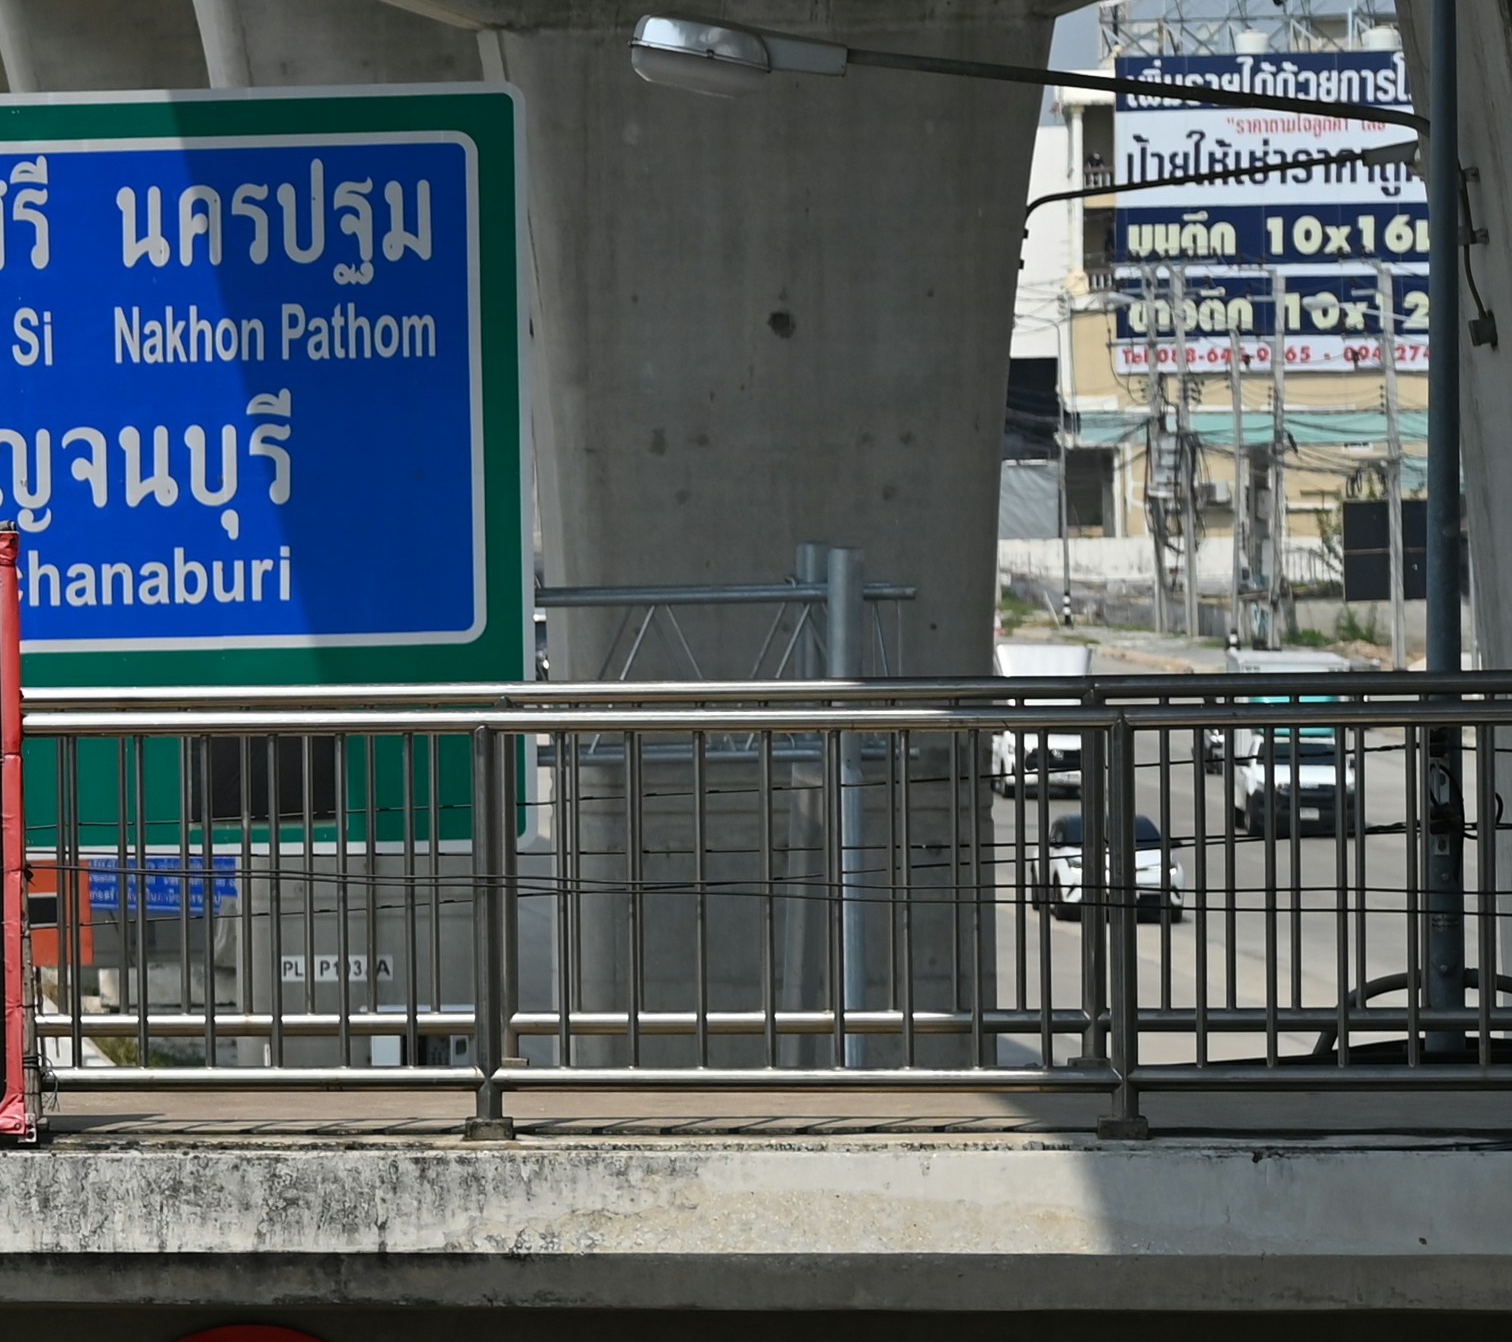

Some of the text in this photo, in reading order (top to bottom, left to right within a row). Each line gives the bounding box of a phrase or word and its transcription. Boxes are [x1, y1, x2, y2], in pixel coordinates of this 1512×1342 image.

[116, 157, 433, 286] นครปฐม
[11, 306, 55, 368] Si
[114, 304, 265, 364] Nakhon
[279, 301, 437, 361] Pathom
[18, 546, 290, 607] hanaburi
